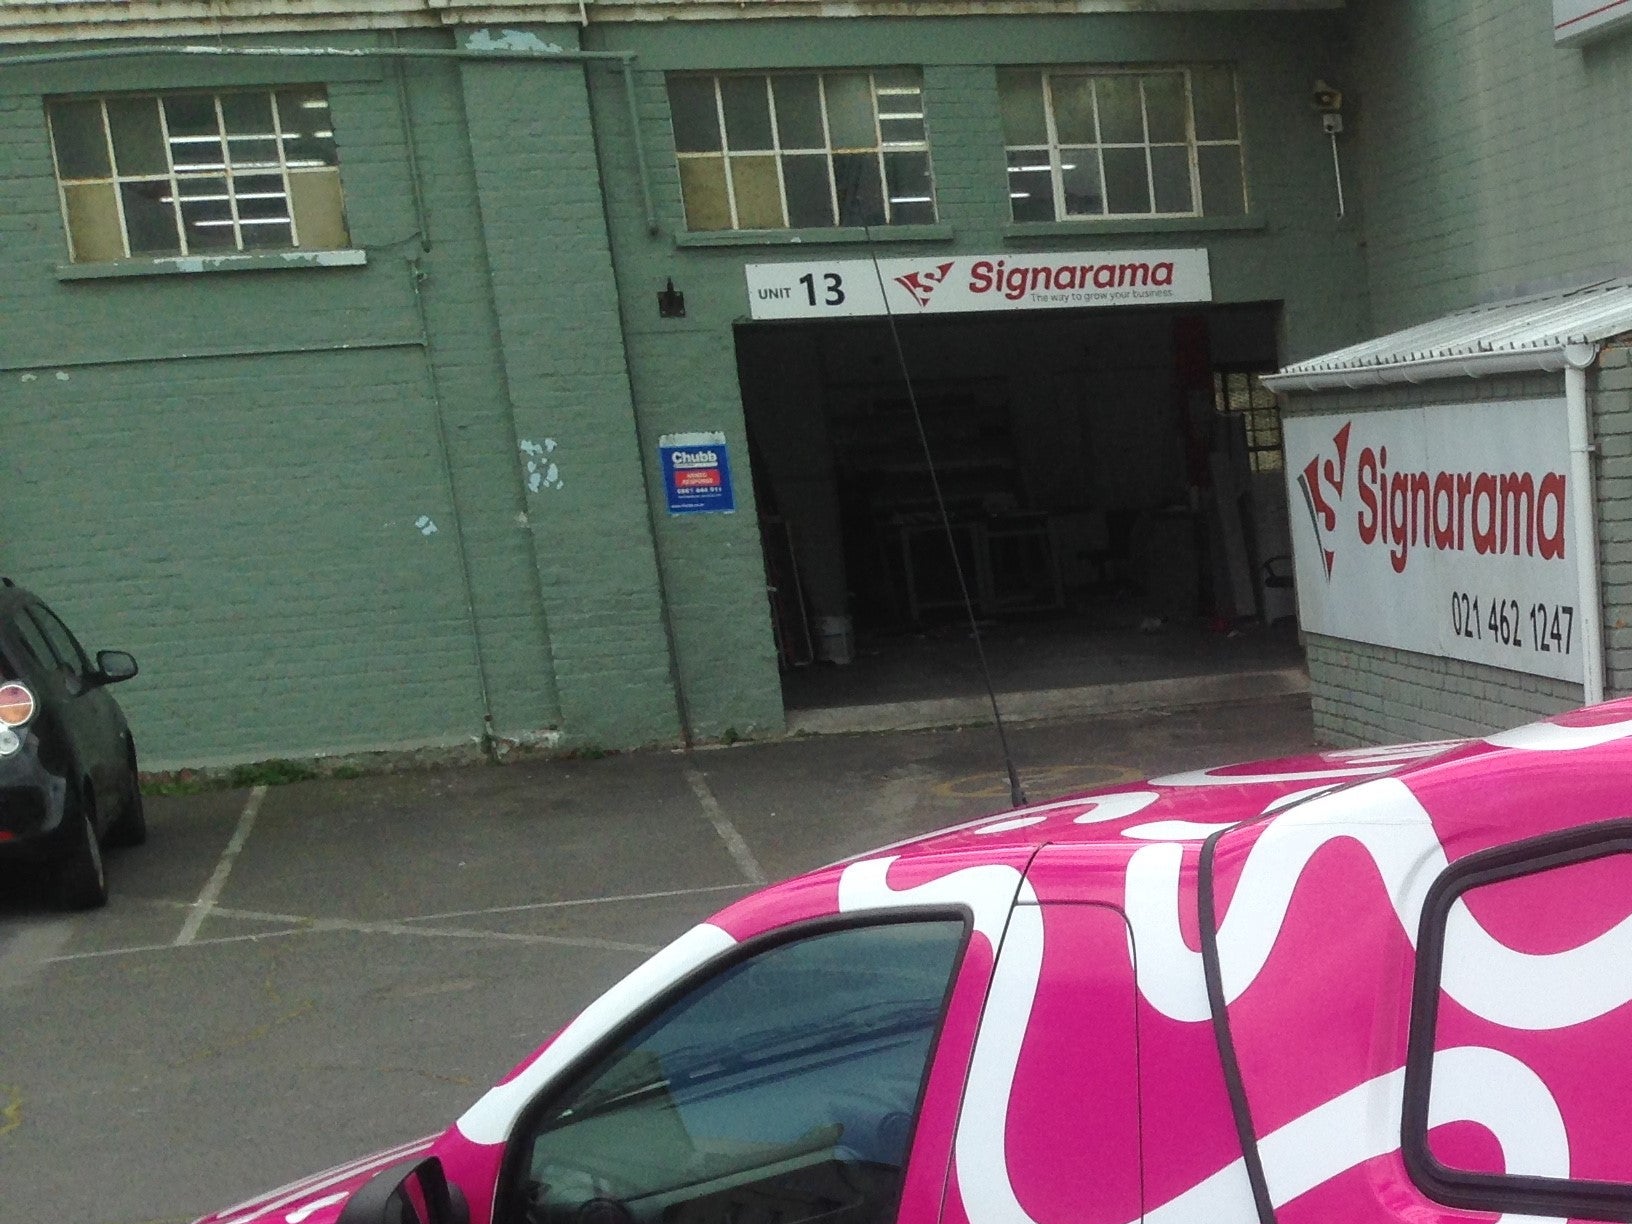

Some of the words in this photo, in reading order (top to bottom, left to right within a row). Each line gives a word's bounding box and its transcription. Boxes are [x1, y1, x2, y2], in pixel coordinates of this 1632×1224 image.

[758, 287, 792, 300] UNIT
[799, 273, 846, 306] 13
[968, 260, 1175, 300] Signarama
[1030, 293, 1049, 302] The
[1050, 294, 1069, 303] way
[1072, 292, 1082, 301] to
[1084, 291, 1108, 302] grow
[1109, 291, 1130, 300] your
[671, 450, 718, 464] Chubb
[1357, 445, 1566, 573] Signarama
[1452, 591, 1482, 640] 021
[1488, 597, 1522, 648] 462
[1530, 602, 1574, 654] 1247
